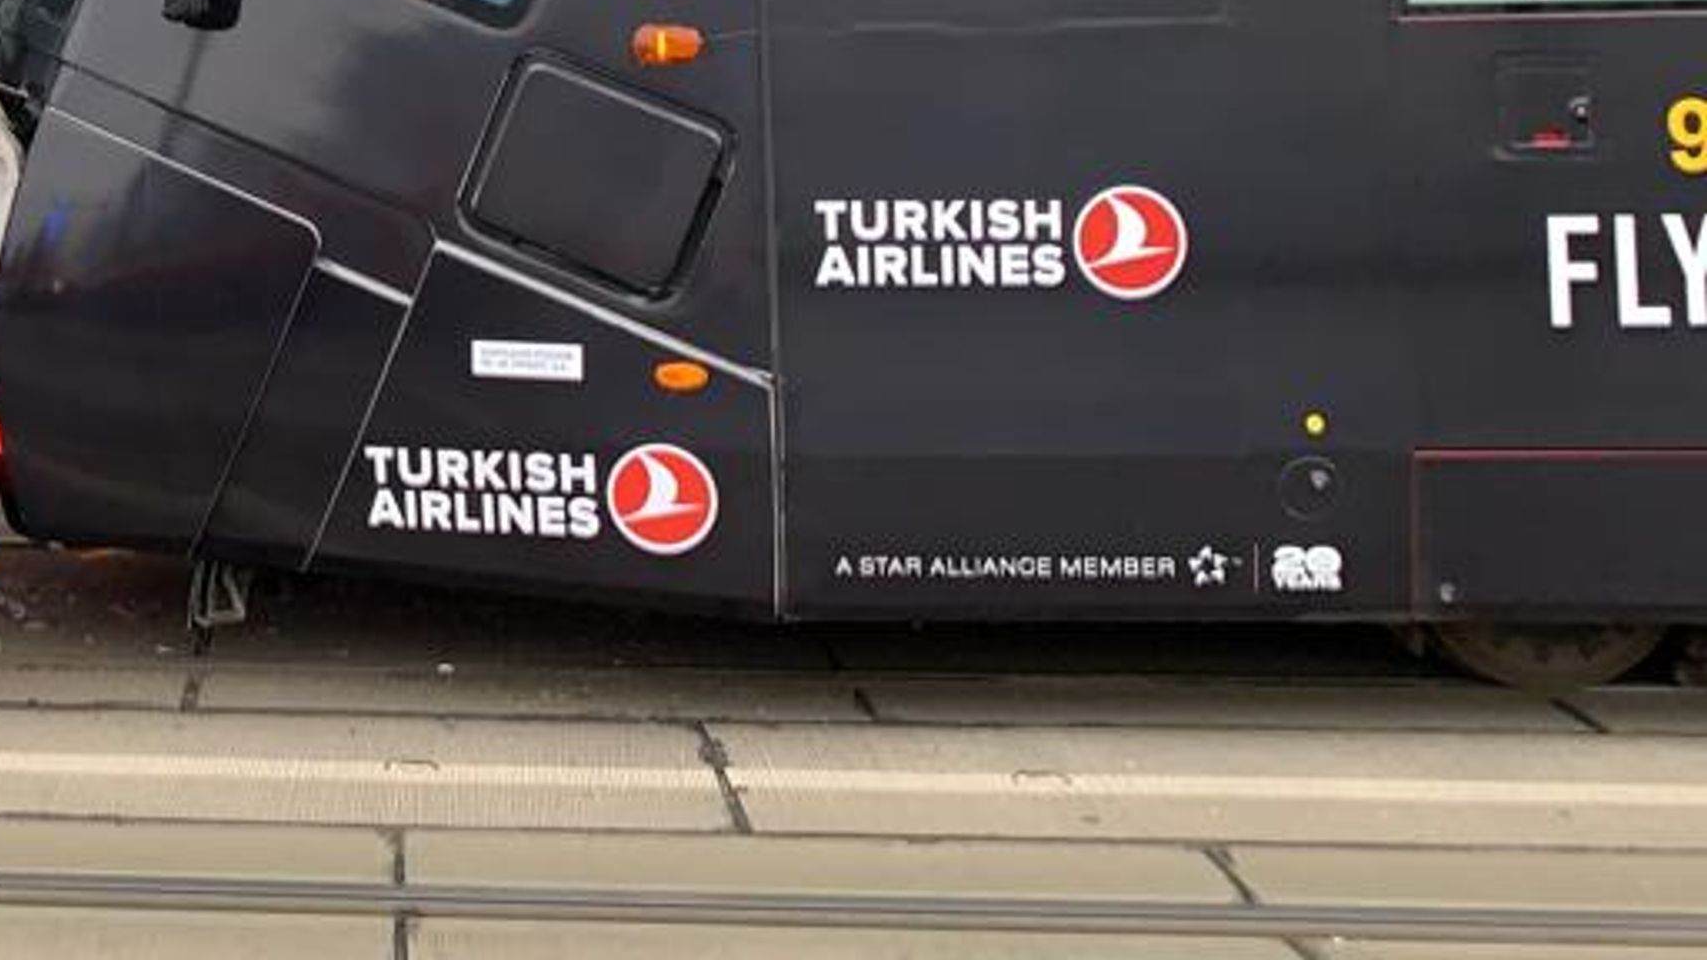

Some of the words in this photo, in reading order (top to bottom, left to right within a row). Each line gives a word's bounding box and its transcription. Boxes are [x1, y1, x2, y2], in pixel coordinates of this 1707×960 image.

[813, 199, 1063, 241] TURKISH
[815, 243, 1066, 287] AIRLINES
[1546, 213, 1707, 328] FLY
[364, 445, 596, 494] TURKISH
[368, 489, 601, 537] AIRLINES
[835, 556, 853, 576] A
[858, 556, 922, 577] STAR
[930, 556, 1052, 577] ALLIANCE
[1060, 556, 1176, 577] MEMBER
